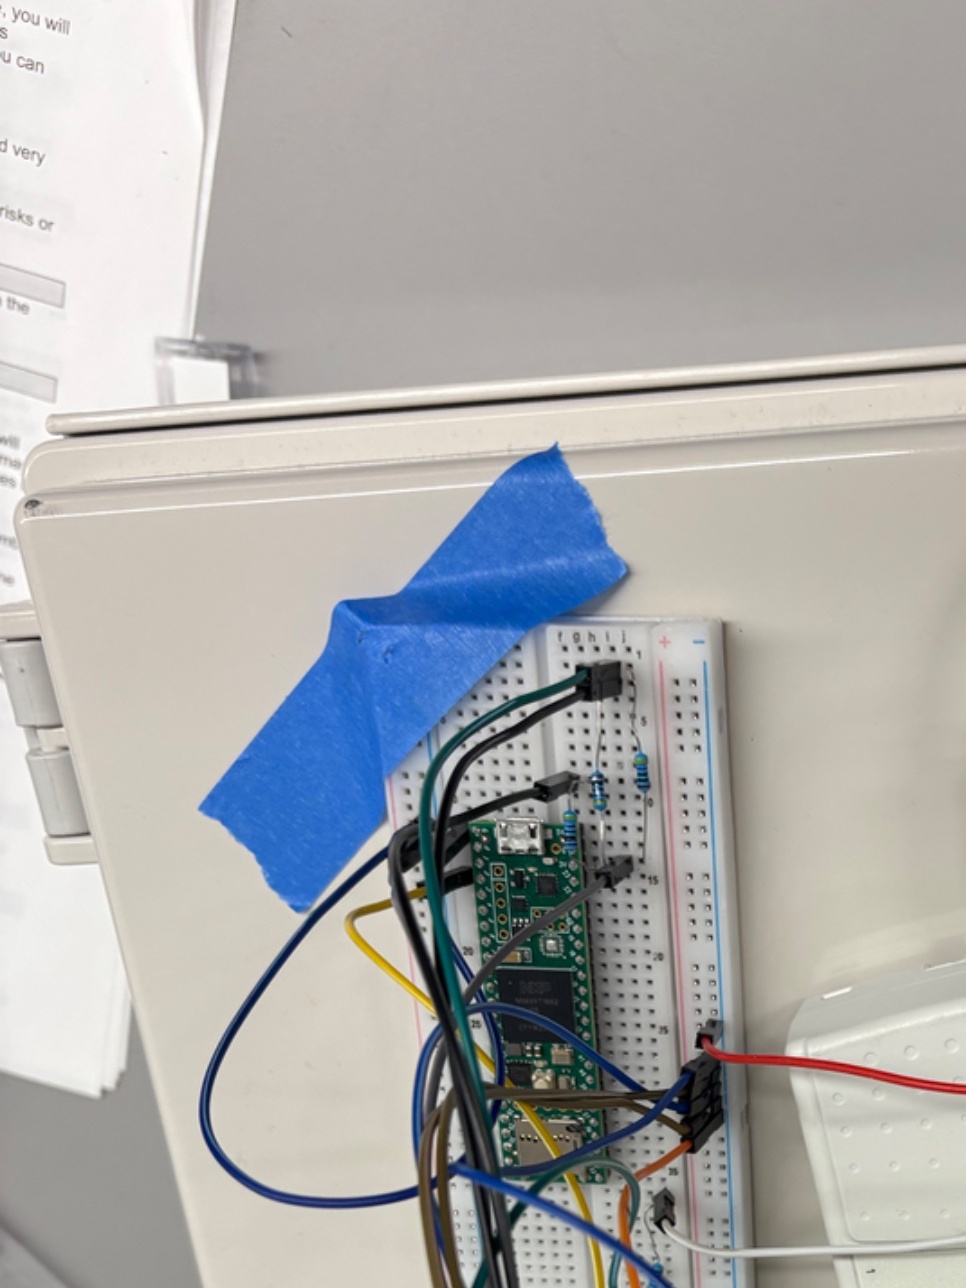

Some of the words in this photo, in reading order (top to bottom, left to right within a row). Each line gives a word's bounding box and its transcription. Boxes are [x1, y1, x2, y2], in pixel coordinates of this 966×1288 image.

[12, 6, 40, 26] you
[45, 16, 70, 35] will
[16, 56, 44, 74] can
[12, 144, 46, 167] very
[38, 218, 54, 232] or
[6, 296, 30, 315] the
